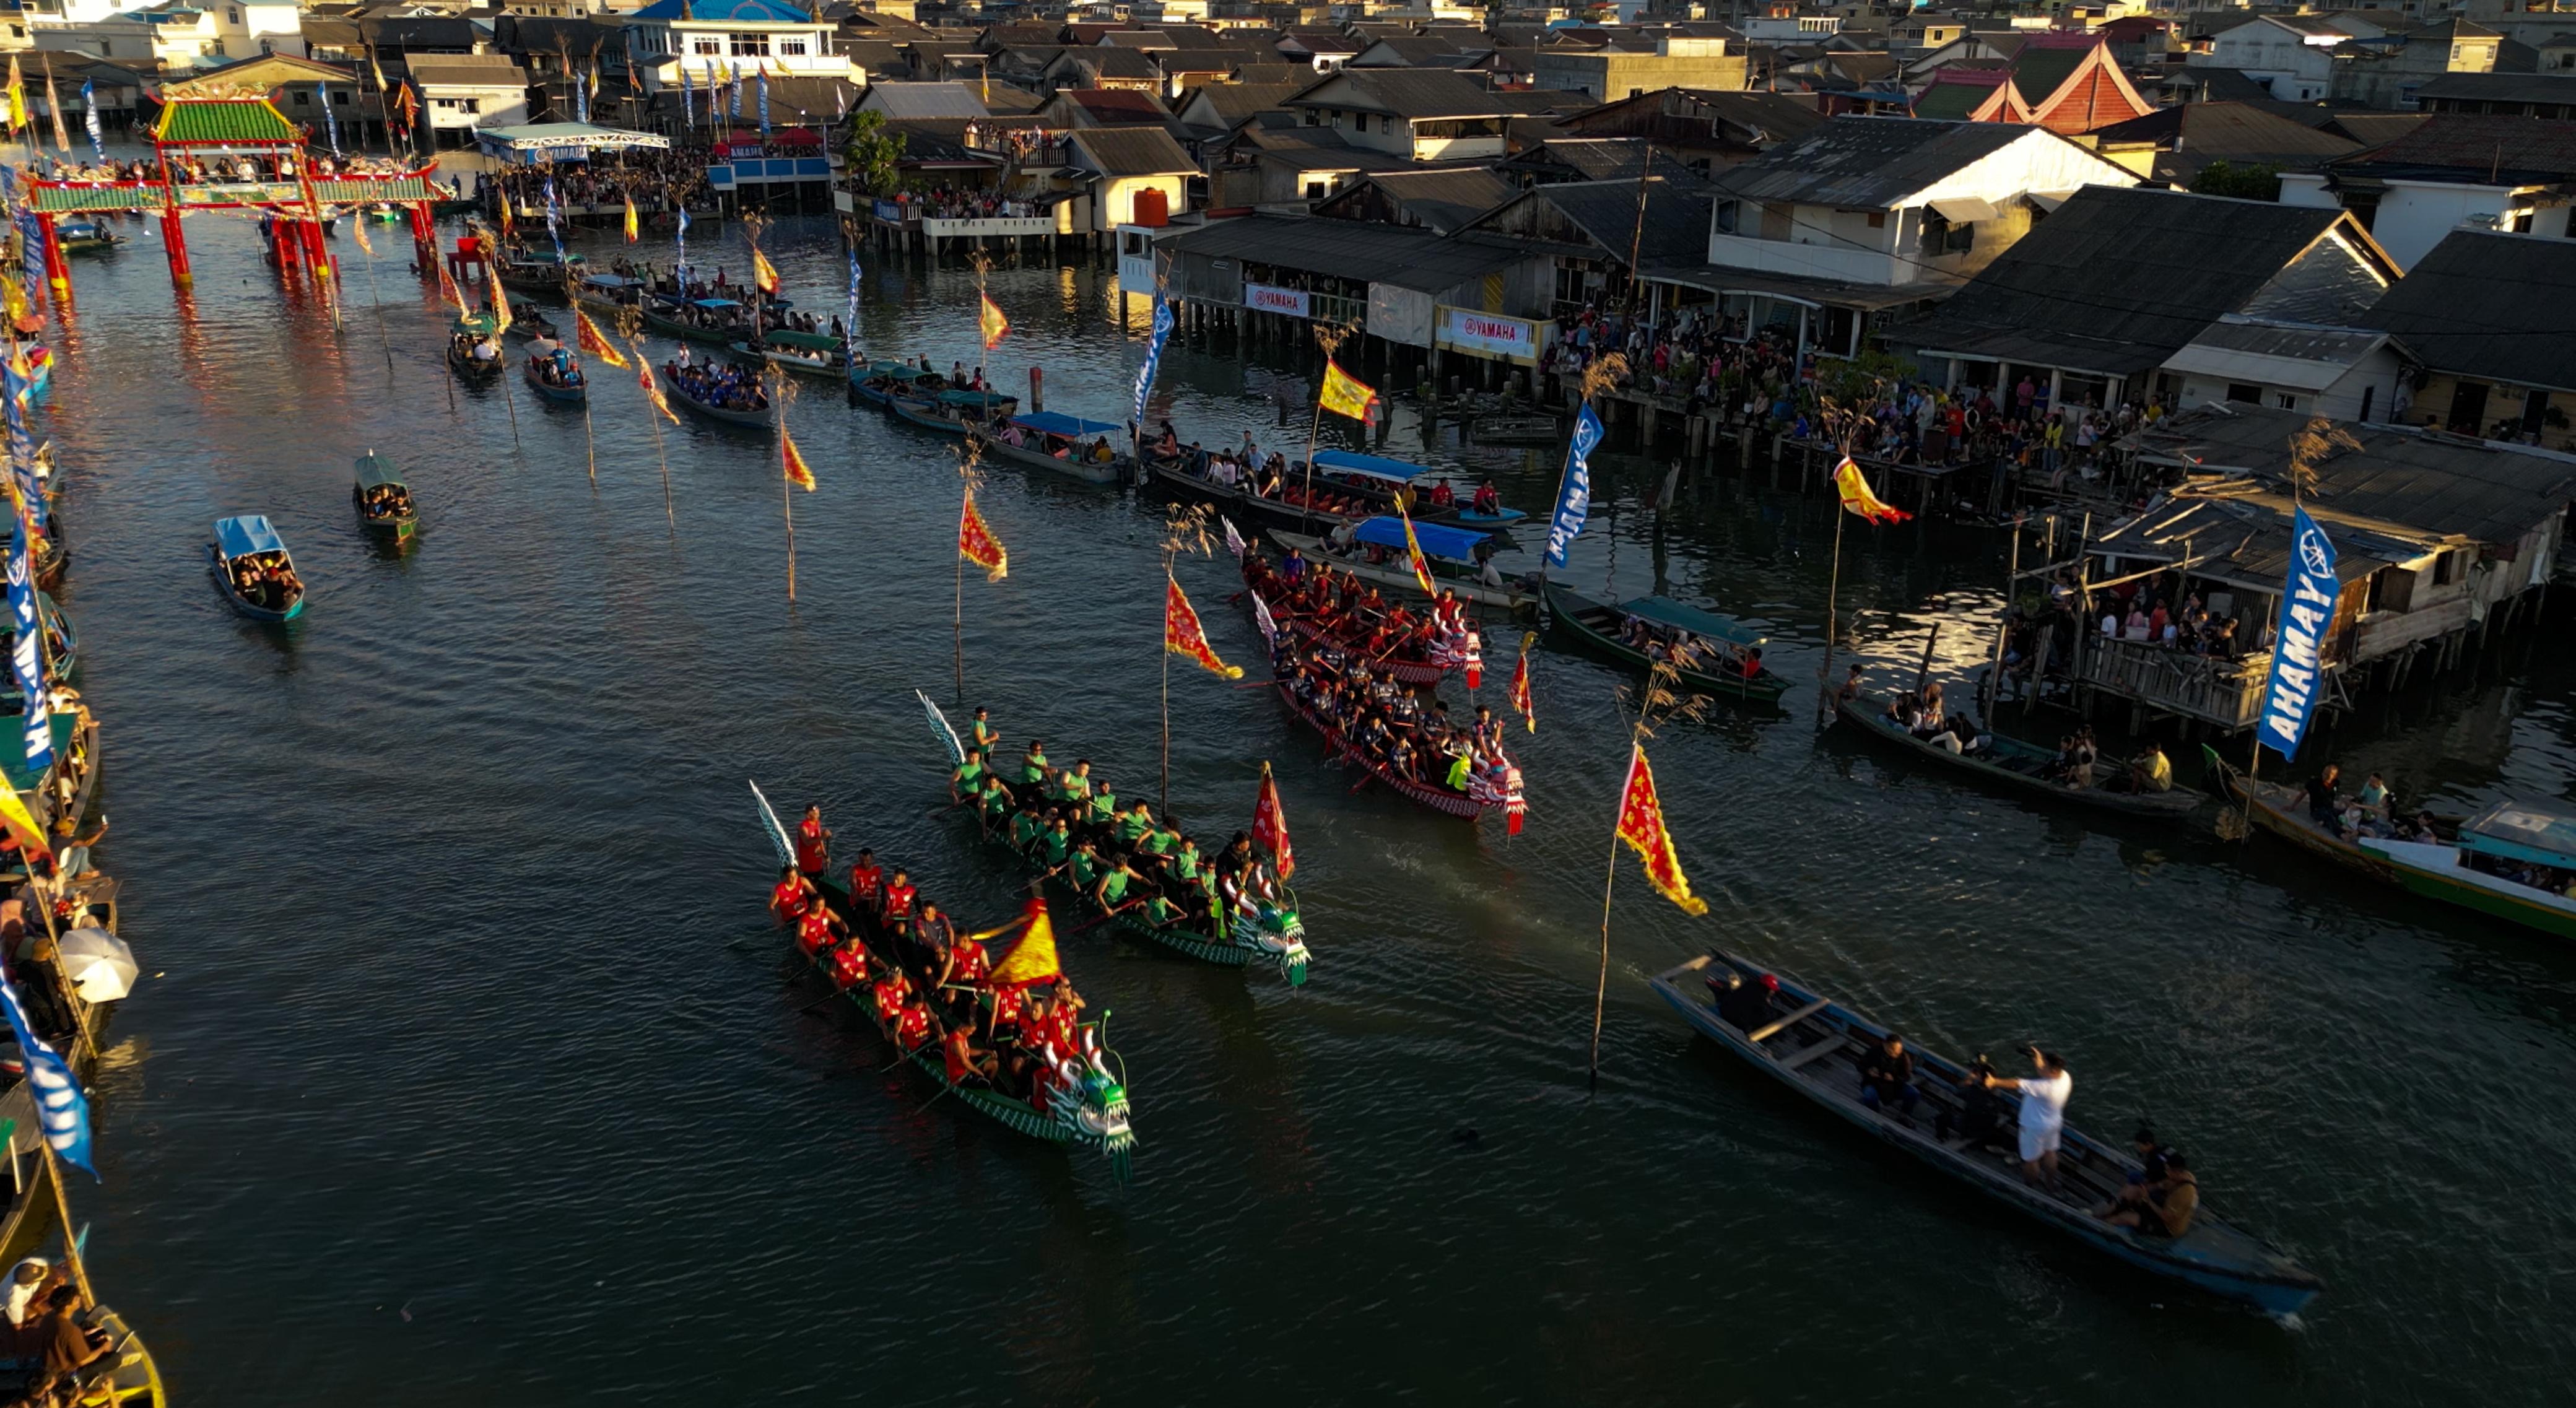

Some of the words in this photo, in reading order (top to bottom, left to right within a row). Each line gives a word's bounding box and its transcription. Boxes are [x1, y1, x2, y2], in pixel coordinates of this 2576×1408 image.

[547, 146, 589, 159] YAMAHA
[731, 147, 764, 157] AMAHA
[1265, 292, 1299, 310] YAMAHA
[1476, 321, 1516, 341] YAMAHA
